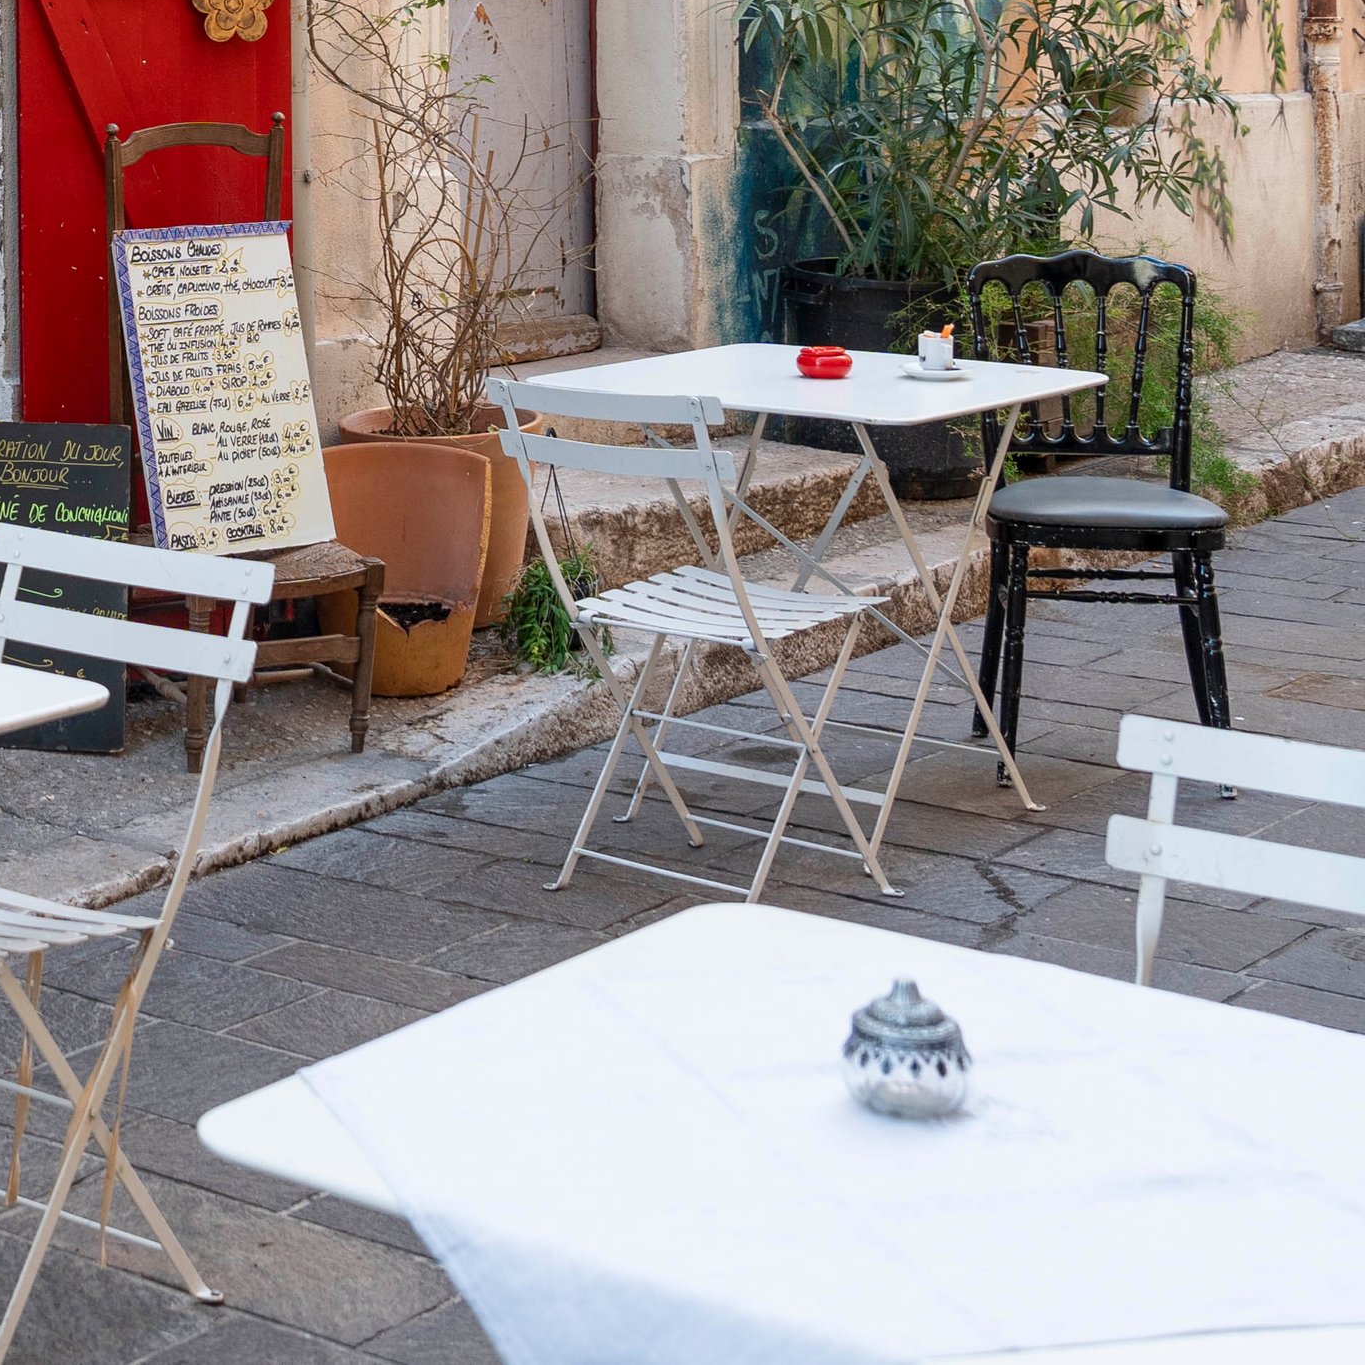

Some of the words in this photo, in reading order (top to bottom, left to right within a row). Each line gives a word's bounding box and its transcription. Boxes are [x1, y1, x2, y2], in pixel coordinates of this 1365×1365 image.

[138, 304, 181, 321] BOISSONS
[150, 354, 168, 368] JUS
[170, 353, 180, 364] DE
[150, 371, 170, 384] JUS
[172, 370, 183, 382] DE
[60, 440, 81, 462] DU
[29, 504, 49, 524] DE
